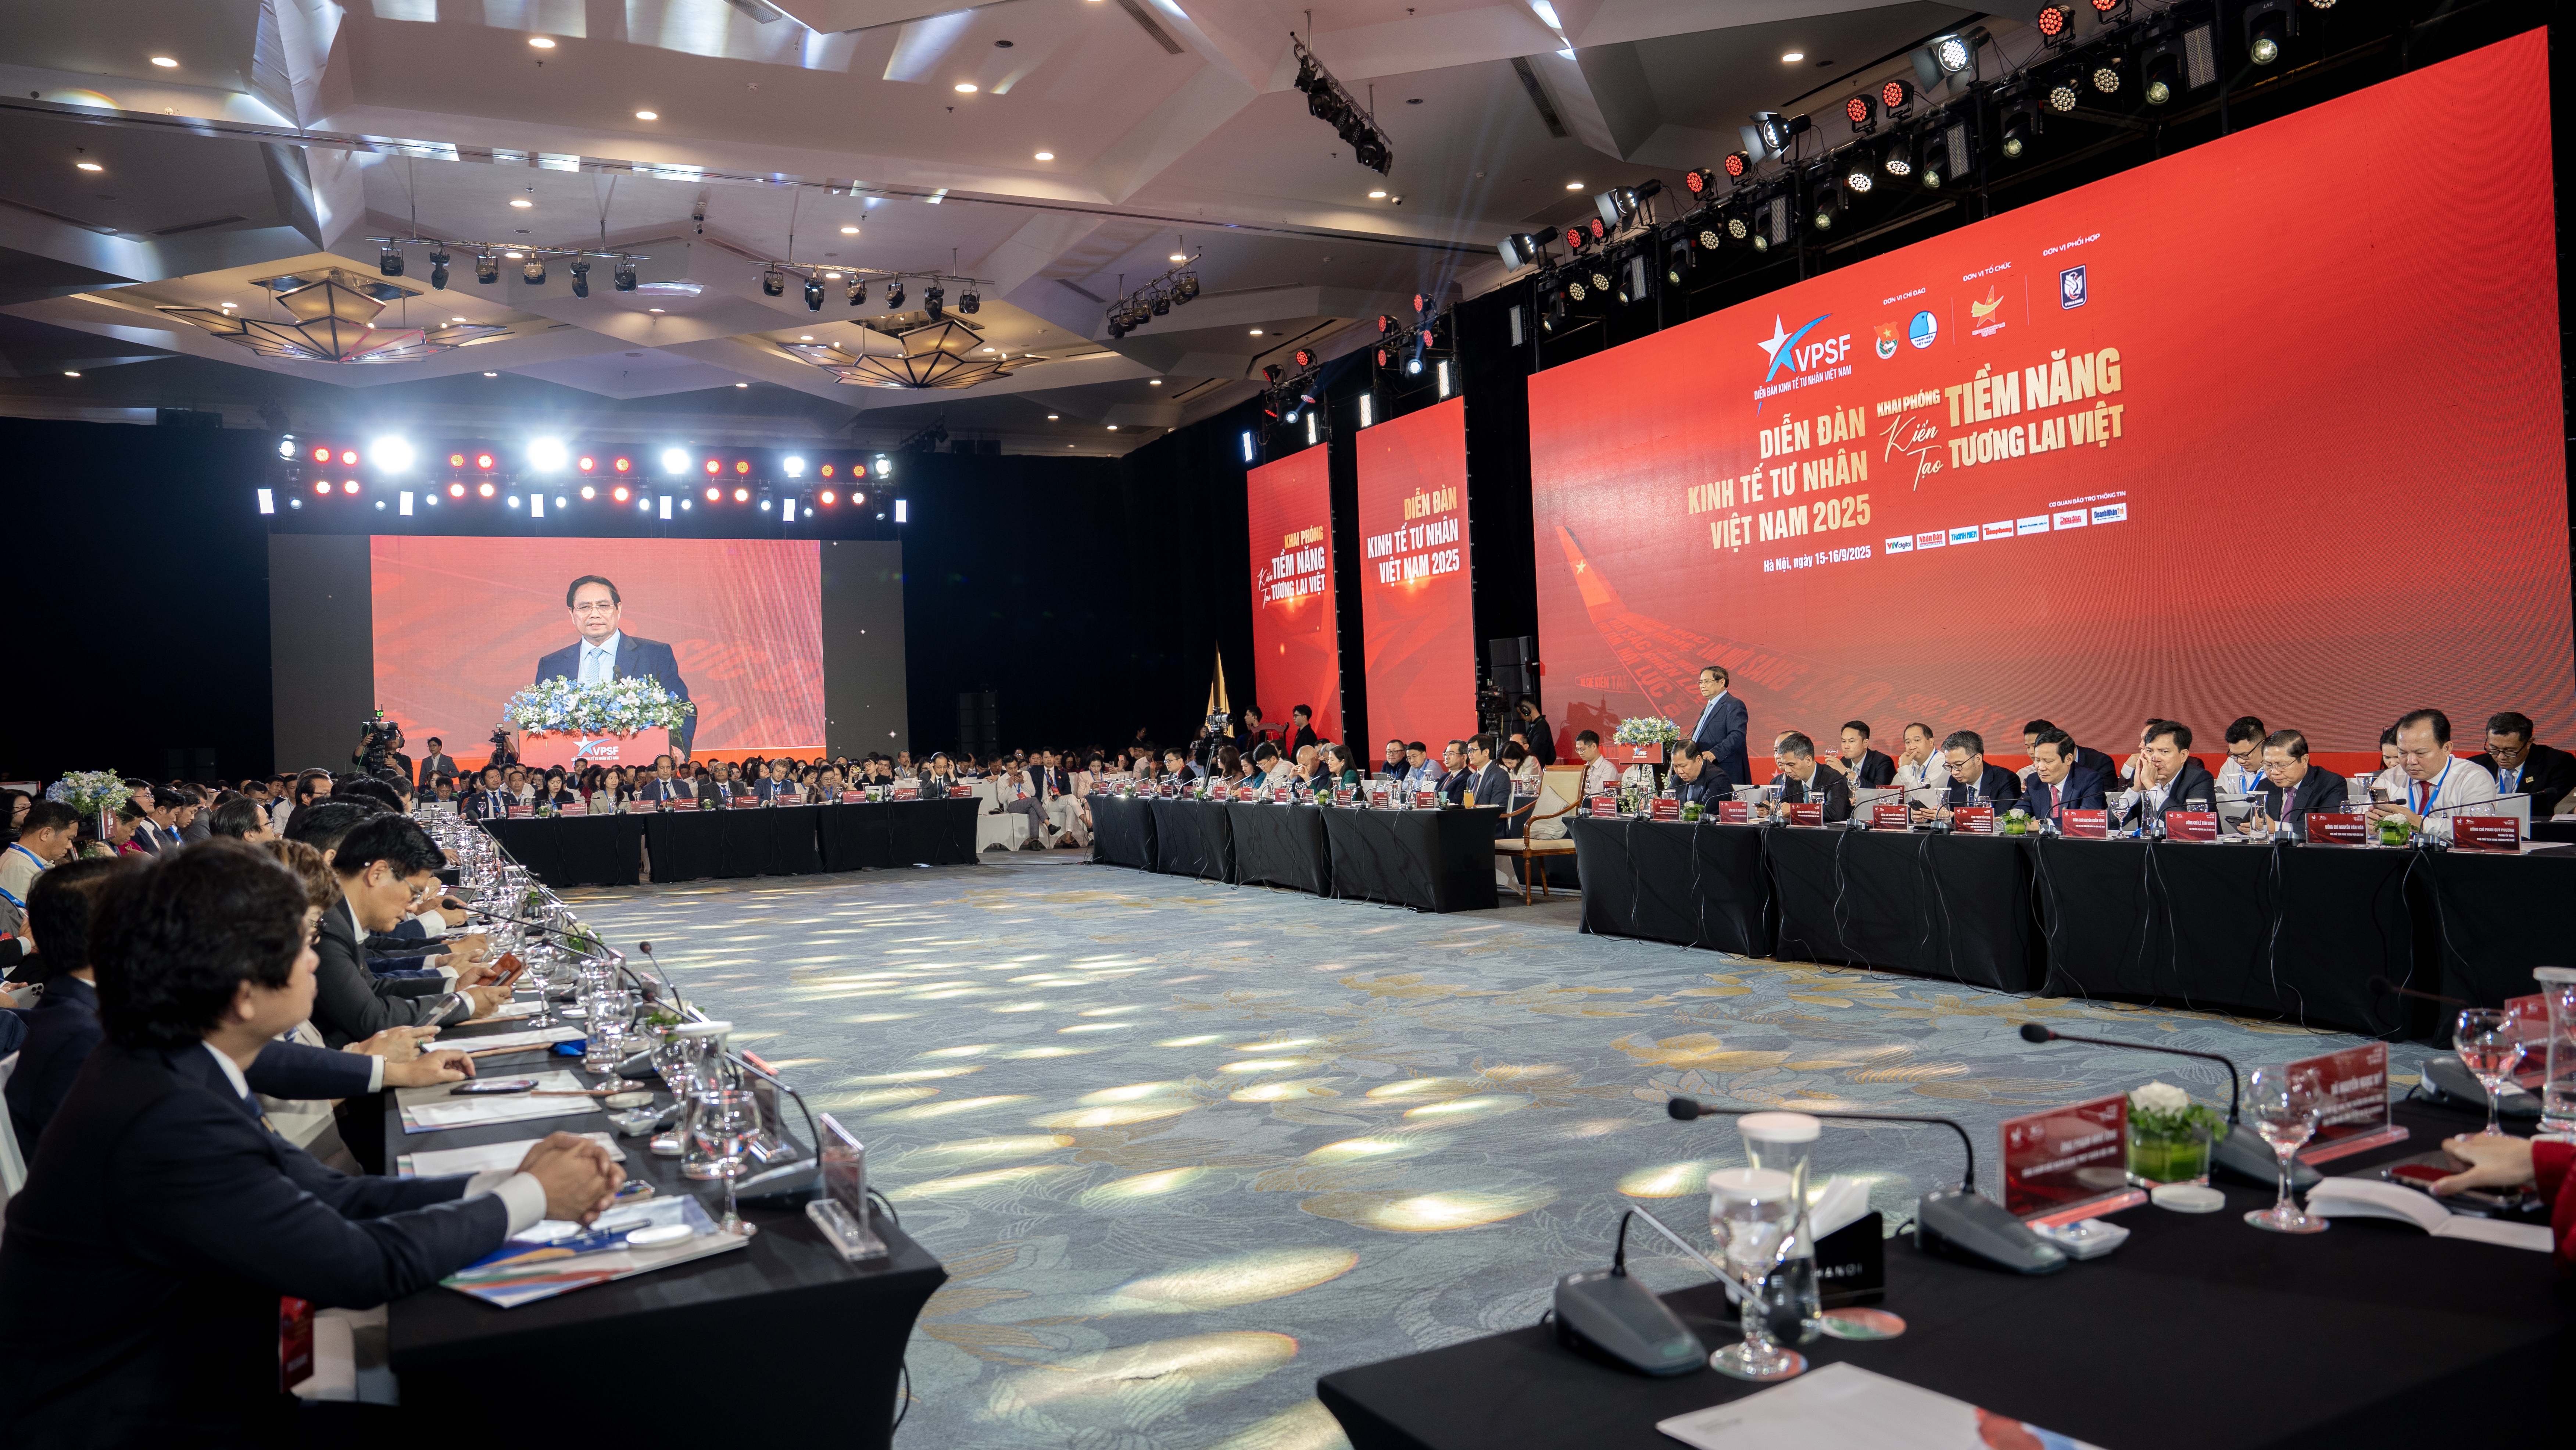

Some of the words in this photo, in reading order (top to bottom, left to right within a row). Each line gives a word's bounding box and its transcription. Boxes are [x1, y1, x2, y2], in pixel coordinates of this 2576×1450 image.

[2043, 247, 2058, 256] ĐƠN
[2067, 236, 2083, 249] PHỐI
[2085, 233, 2100, 243] HỢP
[1963, 272, 1977, 282] ĐƠN
[1994, 261, 2012, 272] CHỨC
[1913, 287, 1926, 296] ĐẠO
[1795, 334, 1851, 372] VPSF
[1754, 386, 1766, 400] DIỄN
[1767, 384, 1778, 397] ĐÀN
[1778, 381, 1791, 393] KINH
[1792, 376, 1799, 389] TẾ
[1800, 376, 1808, 388] TƯ
[1808, 372, 1824, 386] NHÂN
[1824, 368, 1837, 381] VIỆT
[1838, 365, 1852, 377] NAM
[1945, 363, 2021, 428] TIỀM
[2025, 347, 2122, 411] NĂNG
[1877, 398, 1901, 417] KHAI
[1903, 388, 1940, 412] PHÓNG
[1760, 413, 1810, 459] DIỄN
[1817, 405, 1865, 446] ĐÀN
[1879, 414, 1938, 463] Kiến
[1948, 425, 2025, 468] TƯƠNG
[2028, 416, 2065, 454] LAI
[2068, 400, 2124, 448] VIỆT
[1688, 479, 1734, 514] KINH
[1740, 462, 1764, 504] TẾ
[1769, 462, 1797, 498] TƯ
[1803, 448, 1868, 492] NHÂN
[1907, 445, 1943, 492] Tạo
[1404, 487, 1430, 521] DIỄN
[1433, 485, 1457, 513] ĐÀN
[1284, 534, 1299, 549] KHAI
[1300, 525, 1324, 546] PHÓNG
[1367, 533, 1392, 559] KINH
[1394, 522, 1407, 553] TẾ
[1409, 522, 1425, 550] TƯ
[1426, 515, 1459, 548] NHÂN
[1710, 512, 1752, 553] VIỆT
[1759, 505, 1808, 542] NAM
[1813, 493, 1871, 533] 2025
[1272, 549, 1295, 580] TIỀM
[1296, 545, 1325, 575] NĂNG
[1379, 558, 1400, 587] VIỆT
[1403, 552, 1429, 579] NAM
[1432, 549, 1460, 575] 2025
[1764, 559, 1774, 572] Hà
[1776, 556, 1792, 572] Nội,
[1794, 554, 1813, 569] ngày
[1814, 545, 1871, 565] 15-16/9/2025
[1271, 582, 1295, 601] TƯƠNG
[1296, 579, 1309, 596] LAI
[1309, 572, 1325, 595] VIỆT
[593, 746, 619, 756] VPSF
